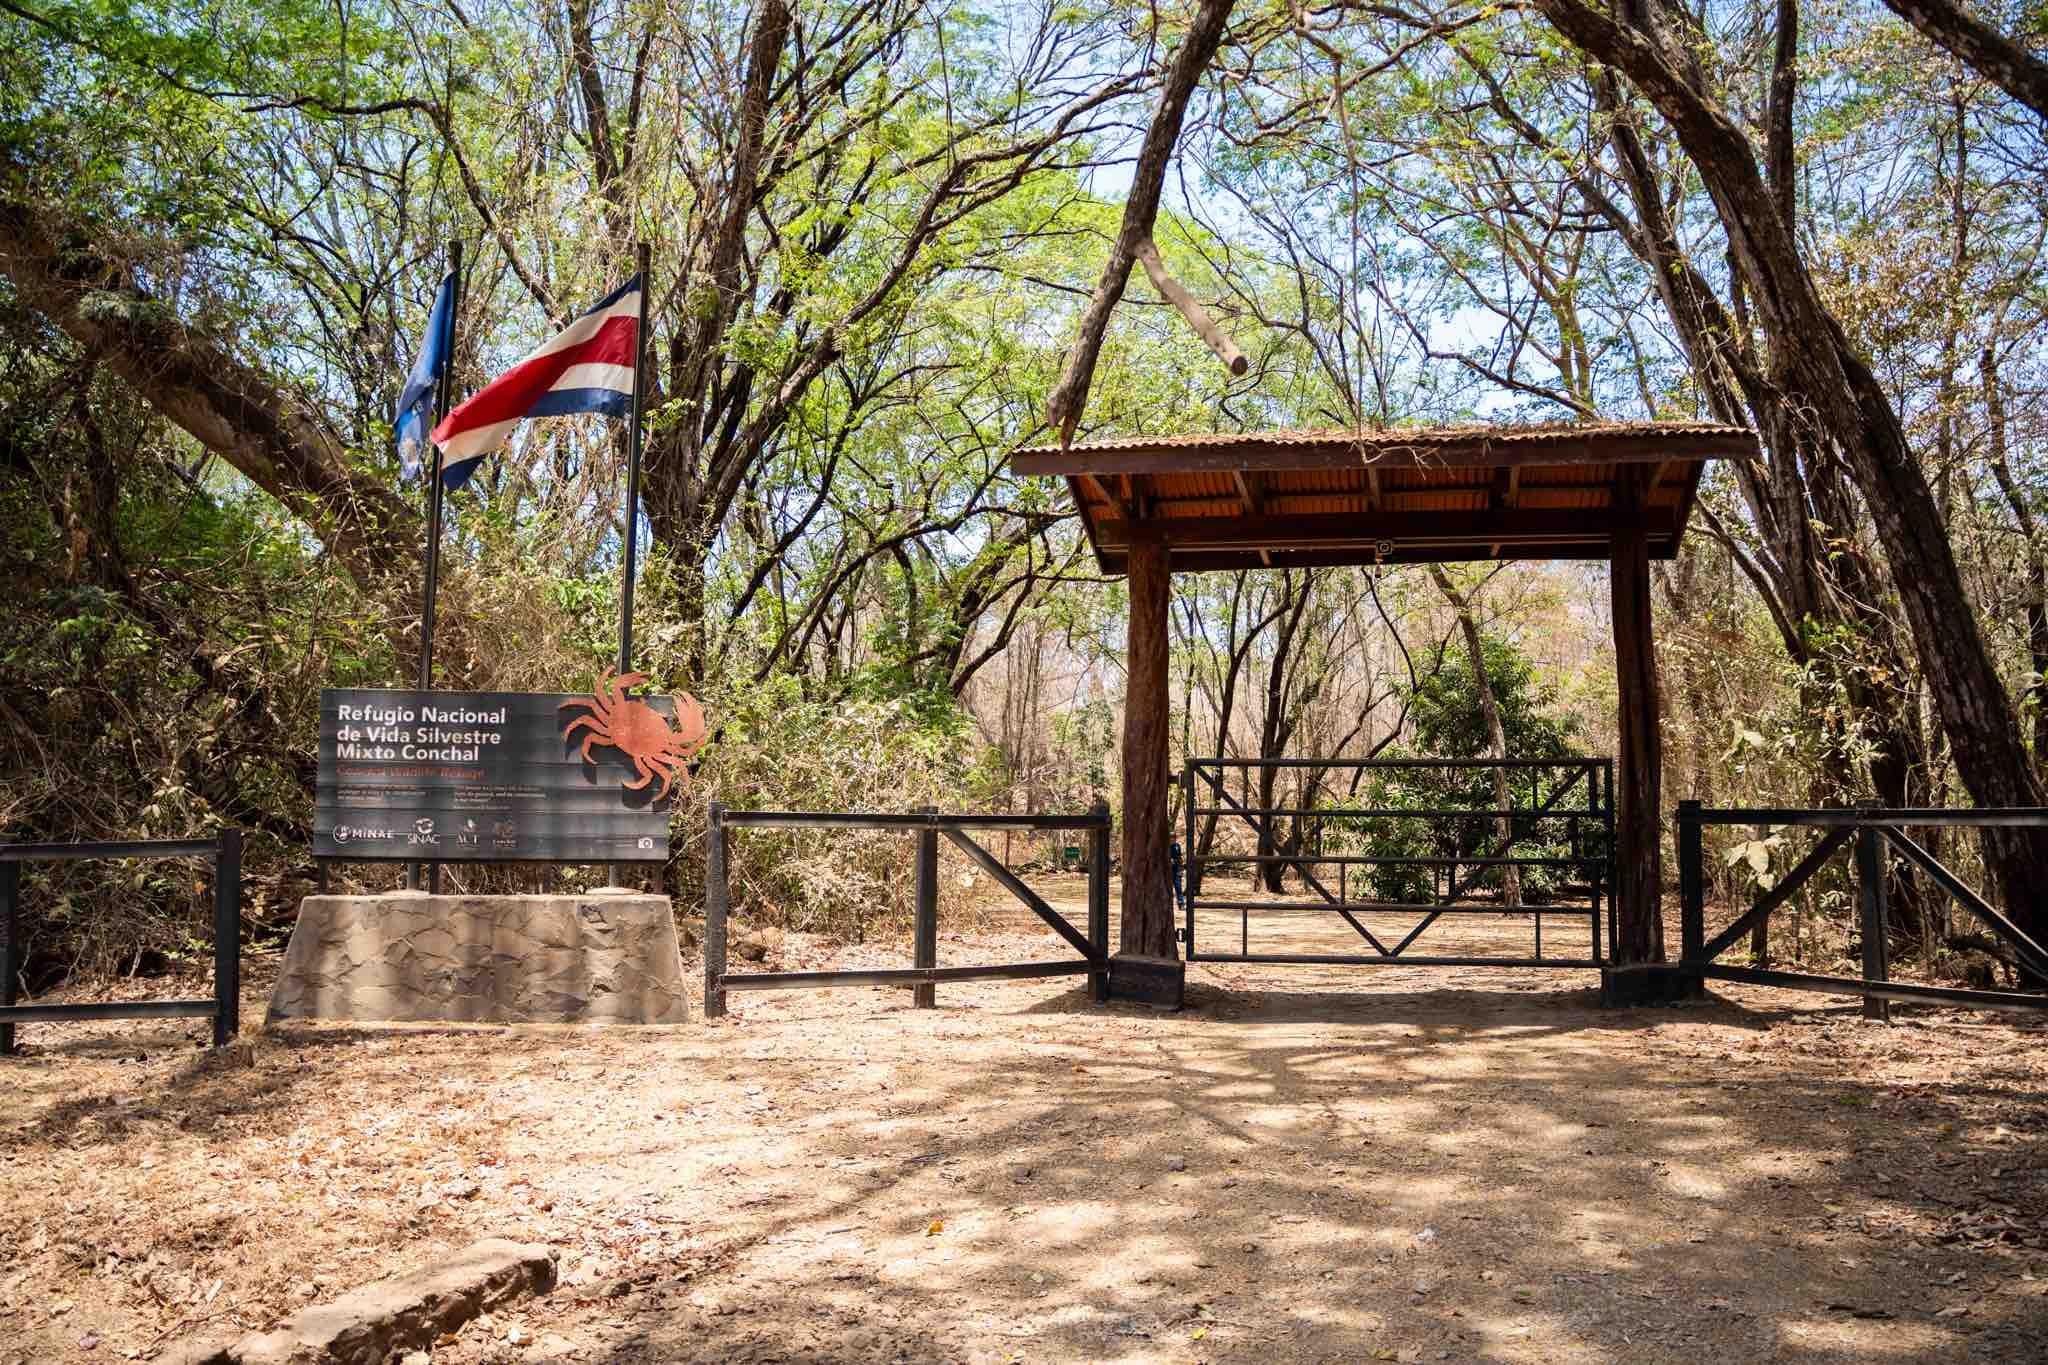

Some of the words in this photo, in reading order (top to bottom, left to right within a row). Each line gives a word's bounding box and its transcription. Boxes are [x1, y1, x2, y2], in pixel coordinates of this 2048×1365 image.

[338, 705, 415, 726] Refugio
[421, 706, 506, 725] Nacional
[337, 725, 361, 742] de
[366, 726, 411, 743] Vida
[416, 727, 502, 745] Silvestre
[336, 743, 395, 760] Mixto
[401, 744, 480, 761] Conchal
